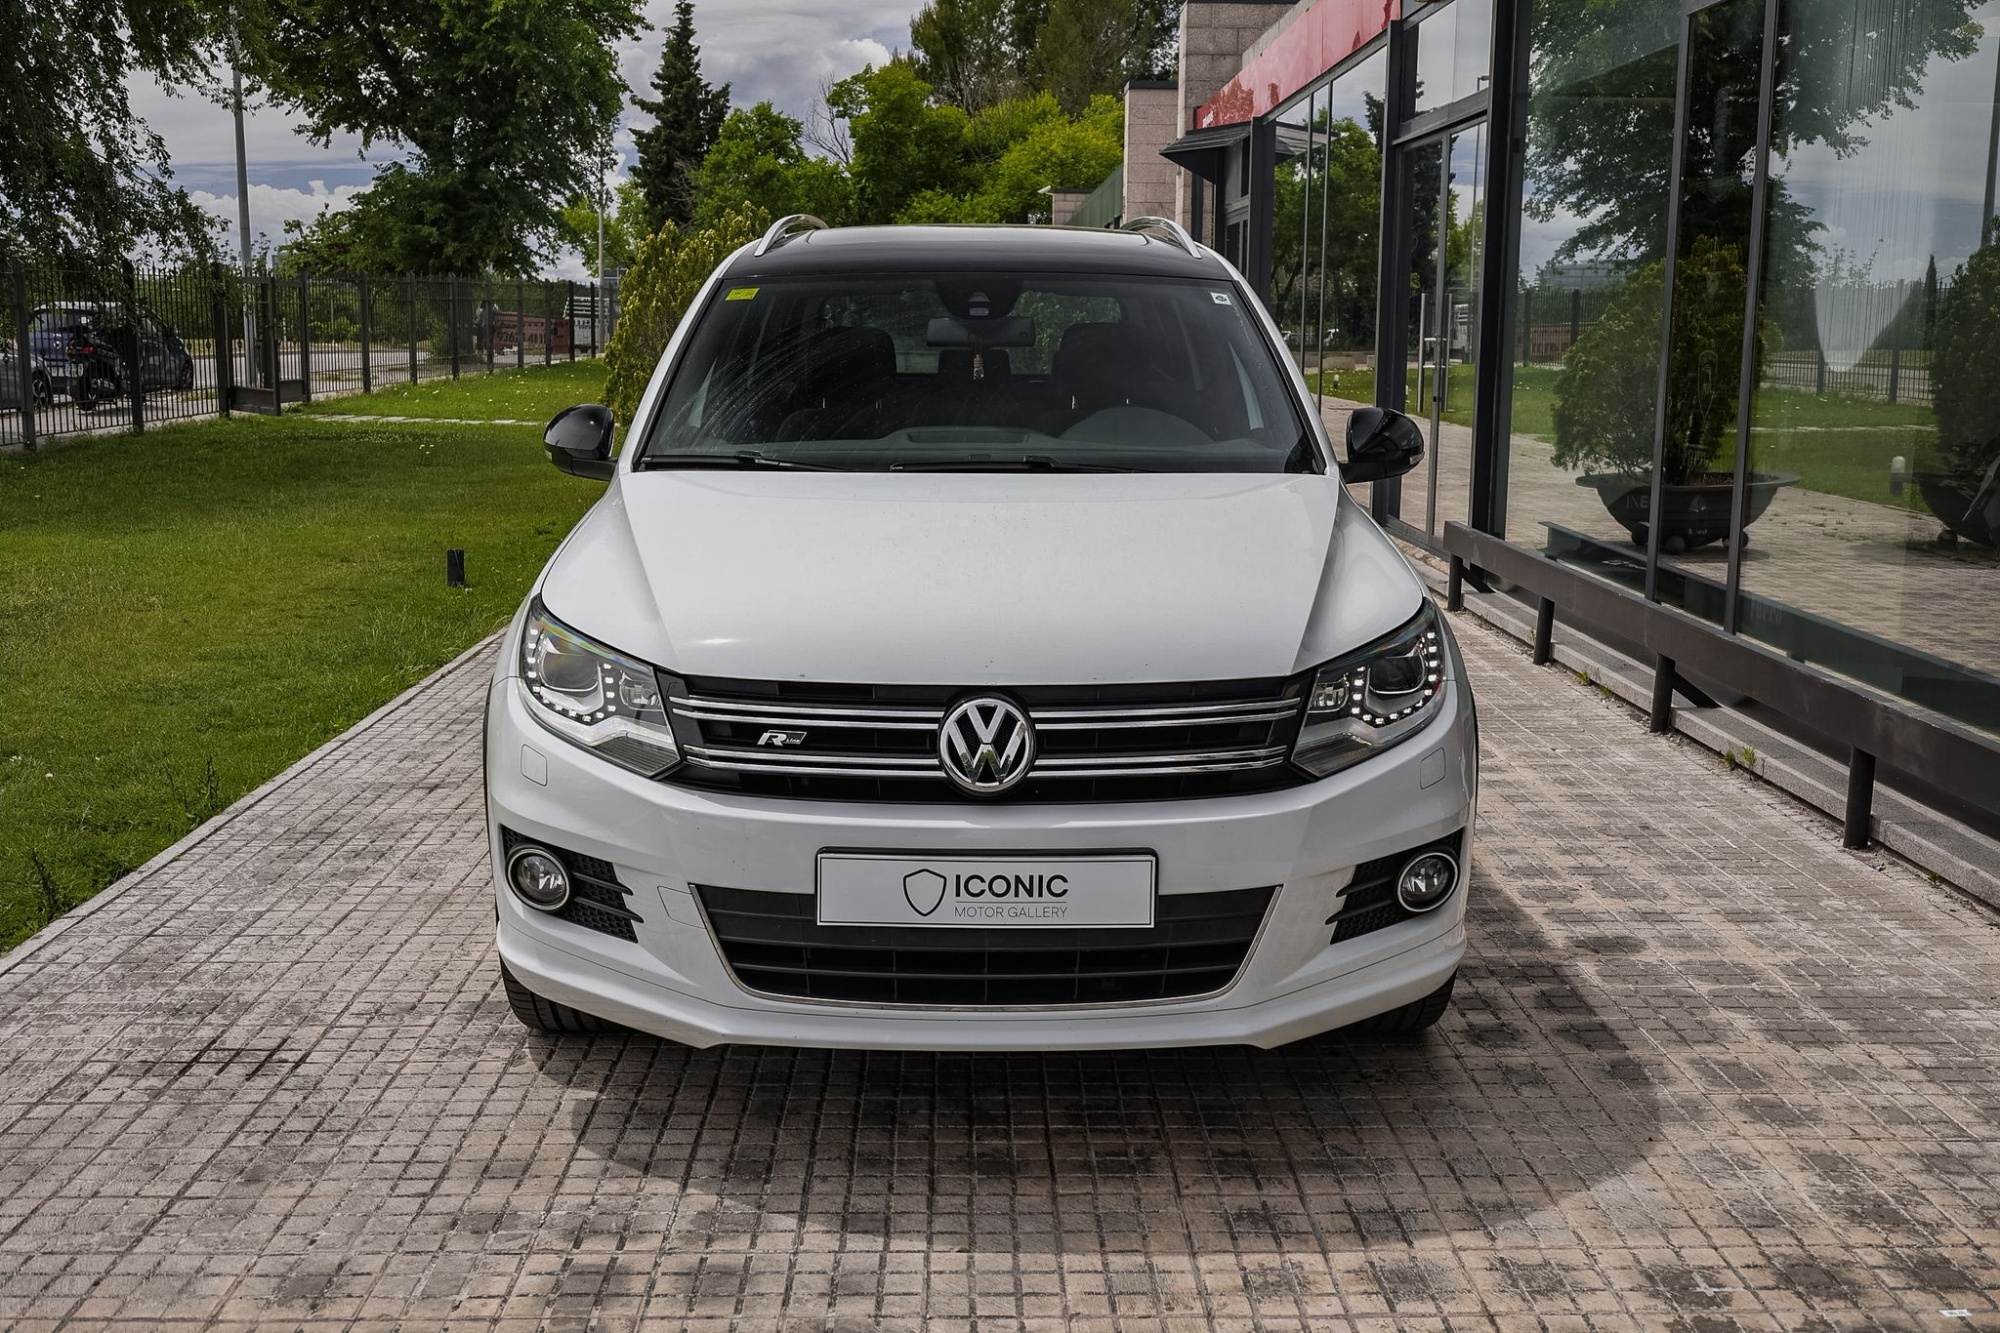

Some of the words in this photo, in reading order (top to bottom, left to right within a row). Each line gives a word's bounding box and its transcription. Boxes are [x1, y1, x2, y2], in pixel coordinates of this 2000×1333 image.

[955, 874, 1069, 898] ICONIC
[954, 906, 1004, 918] MOTOR
[1008, 906, 1067, 918] GALLERY
